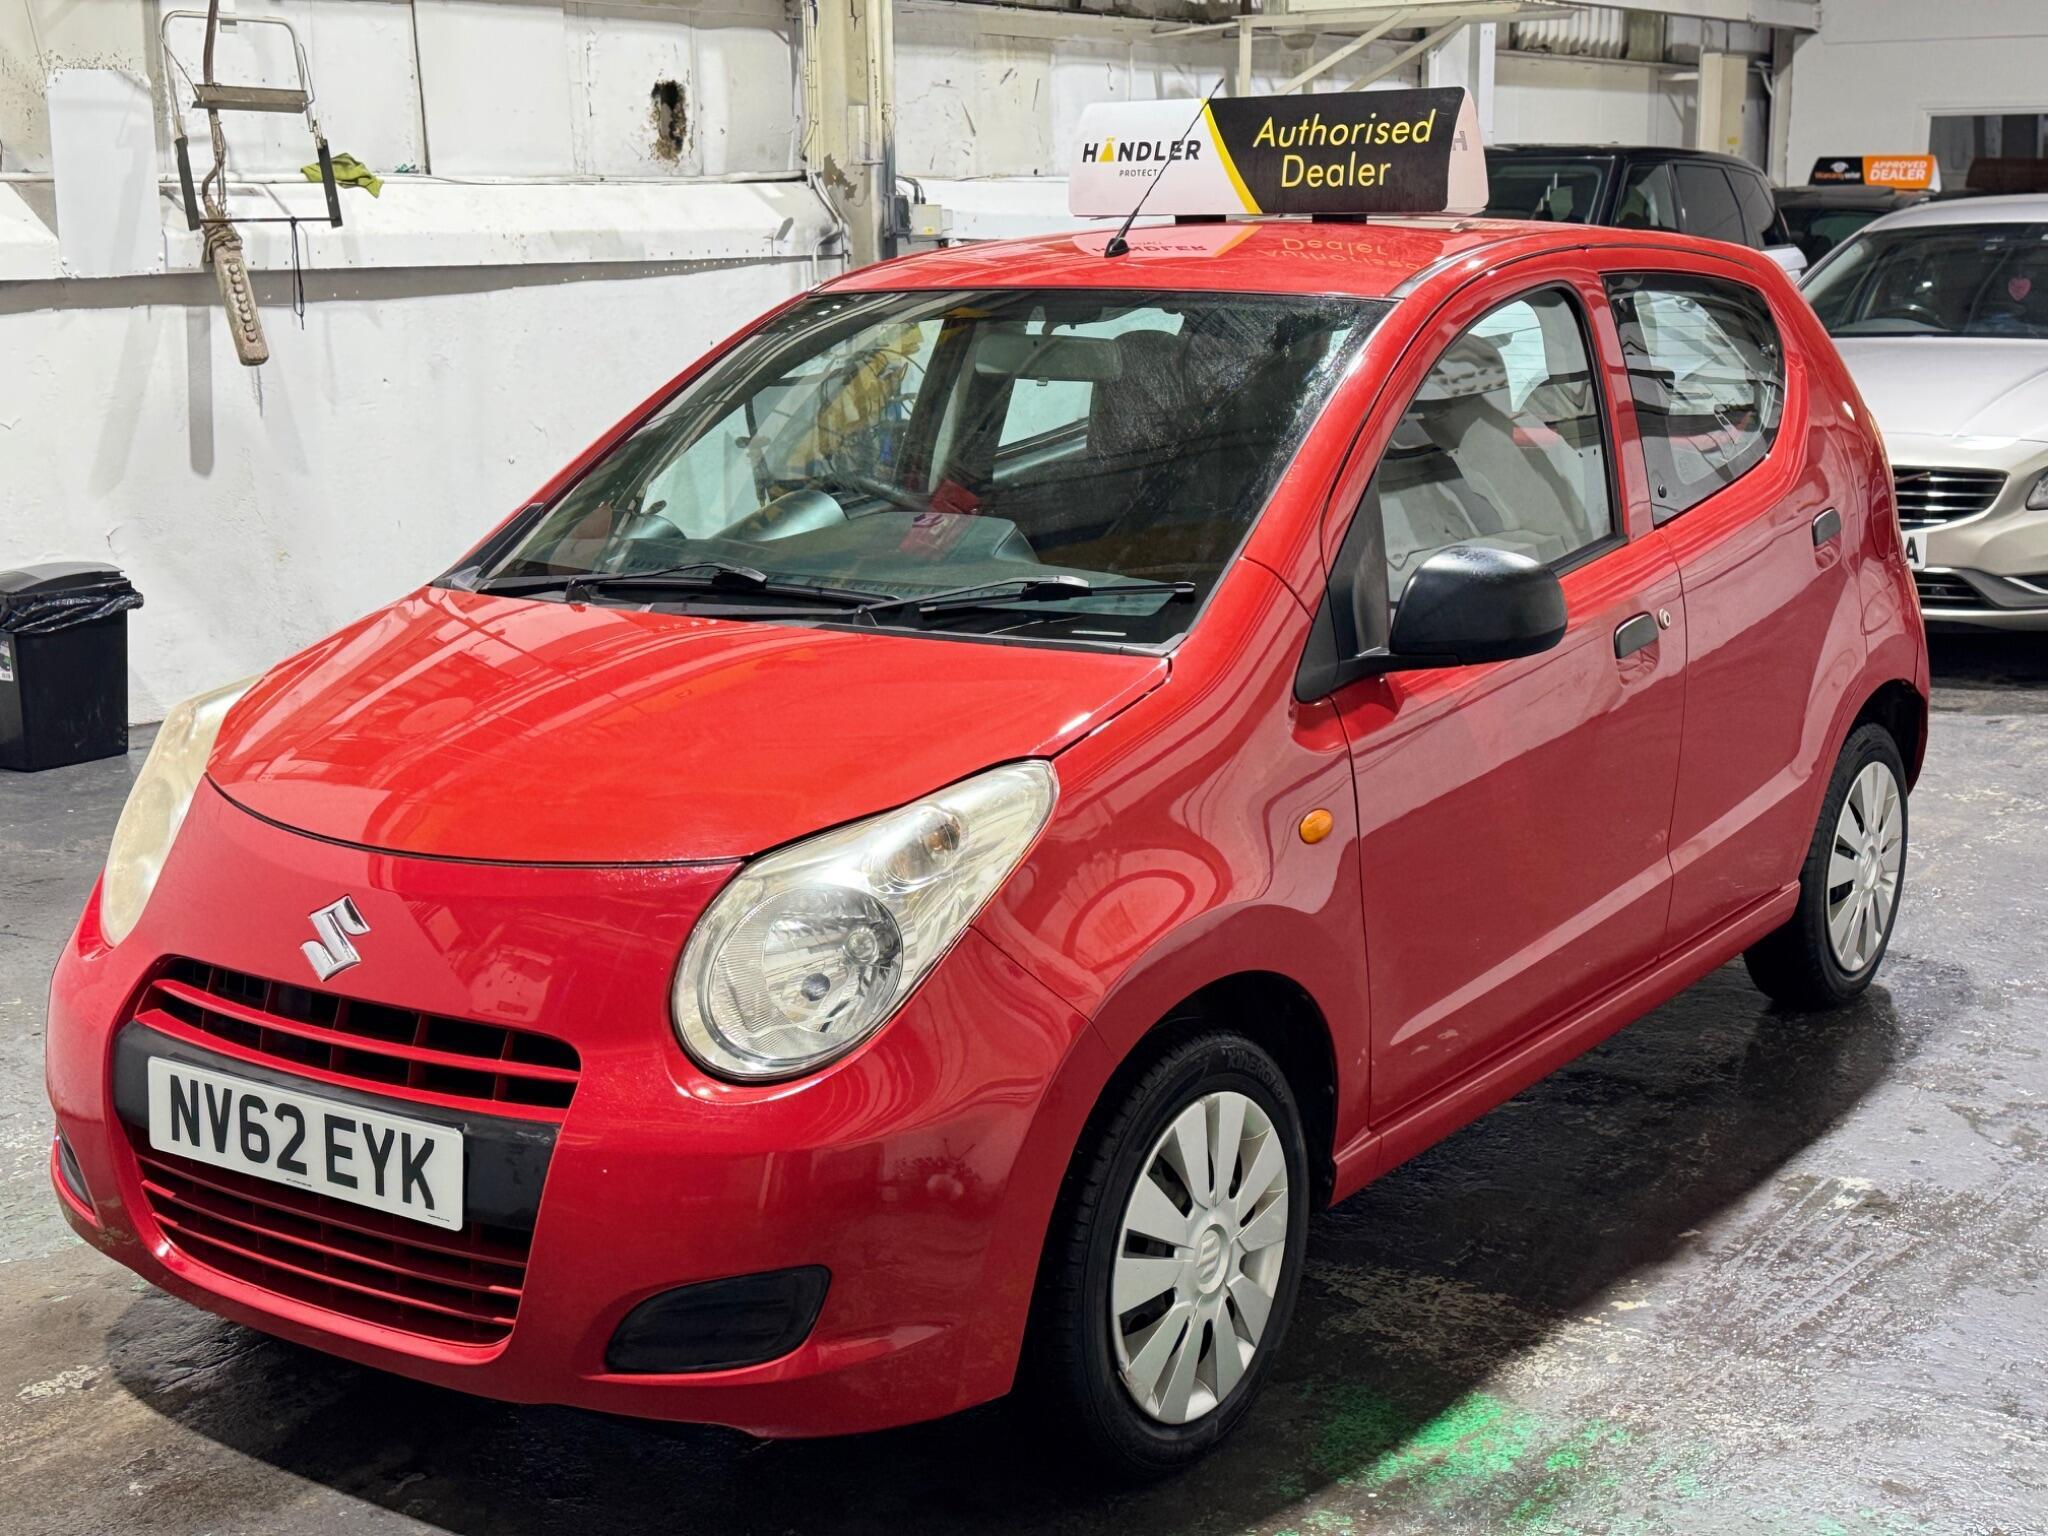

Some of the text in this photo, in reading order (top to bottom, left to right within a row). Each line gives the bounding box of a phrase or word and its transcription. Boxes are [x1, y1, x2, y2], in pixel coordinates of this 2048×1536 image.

[1253, 108, 1437, 149] Authorised
[1082, 136, 1202, 162] HÄNDLER
[1119, 168, 1158, 177] PROTECT
[1281, 152, 1392, 188] Dealer
[1870, 169, 1926, 180] DEALER
[1871, 160, 1927, 169] APPROVED
[170, 1074, 435, 1211] NV62 EYK
